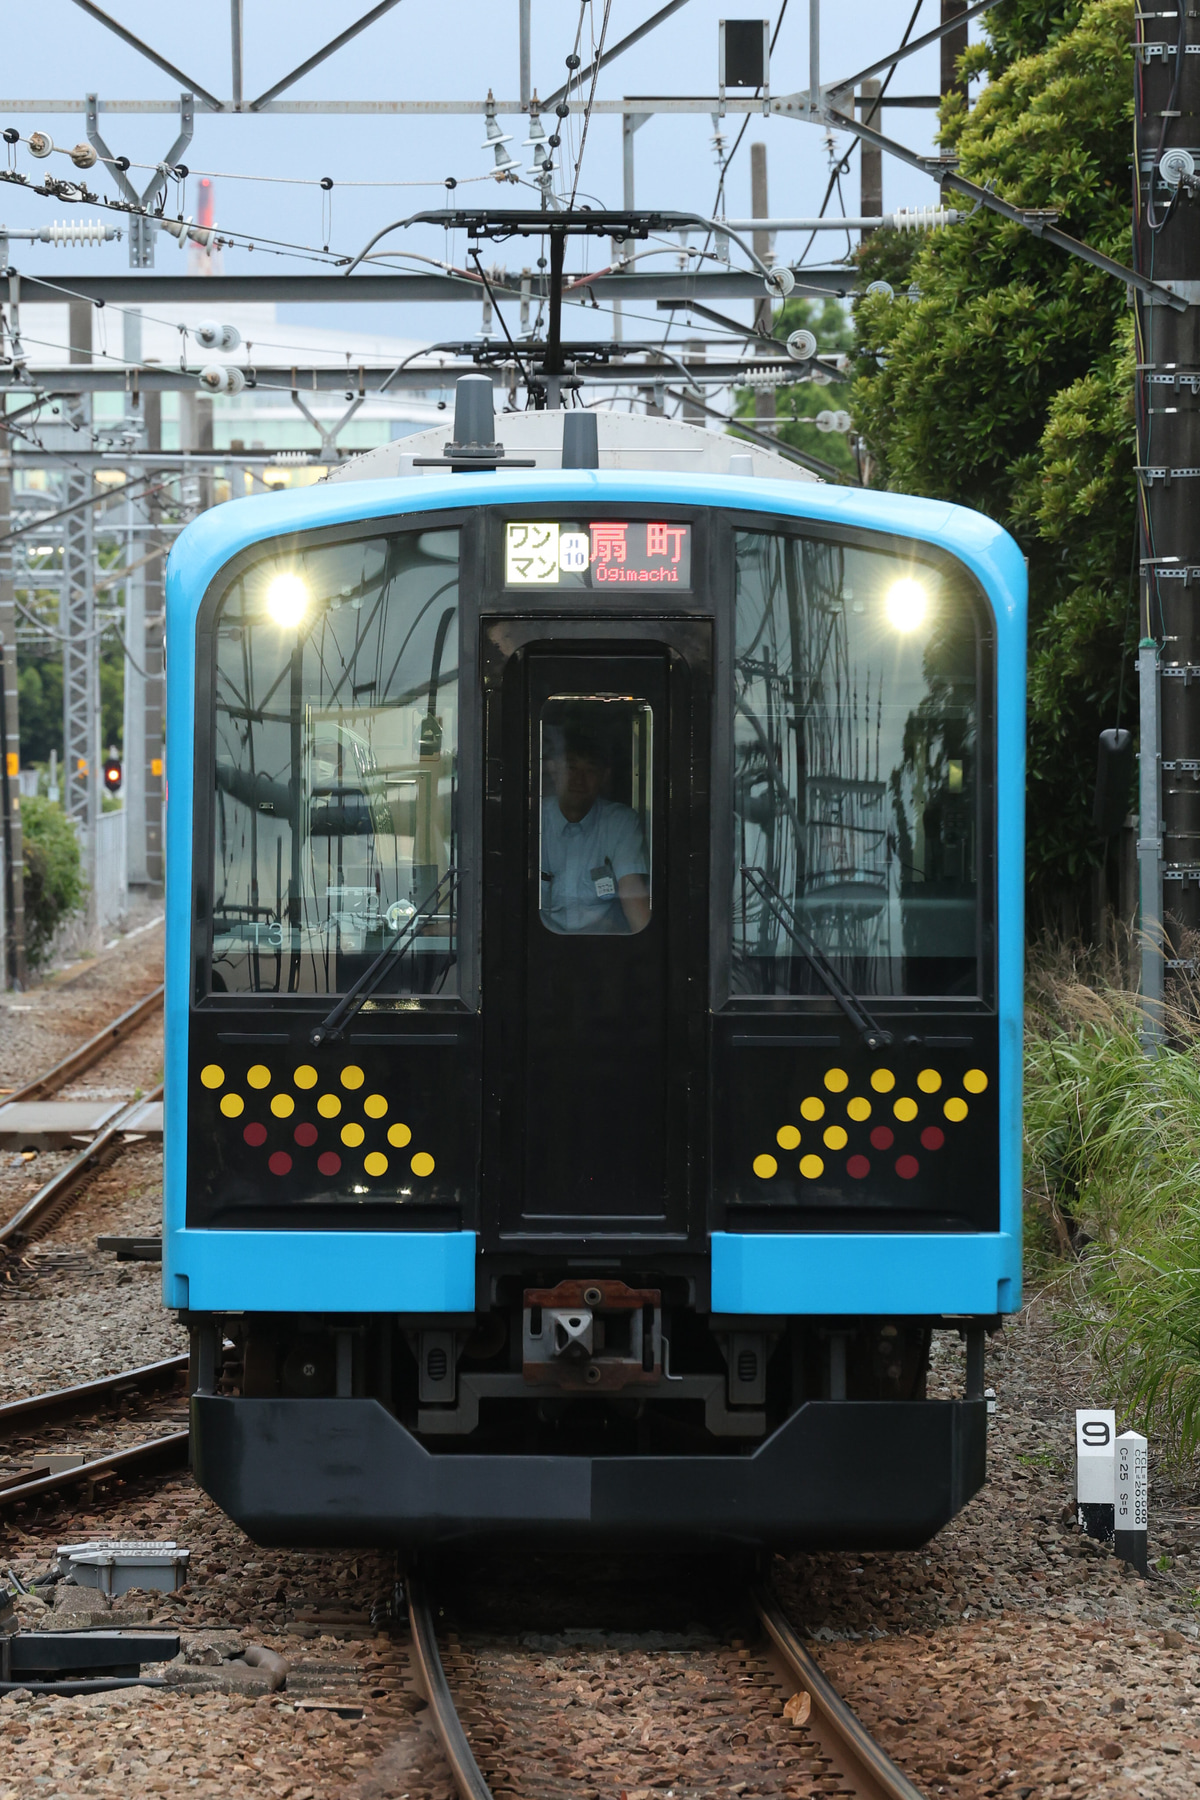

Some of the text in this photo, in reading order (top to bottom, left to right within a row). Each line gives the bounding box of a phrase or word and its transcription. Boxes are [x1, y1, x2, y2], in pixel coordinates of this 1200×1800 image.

[509, 525, 551, 549] ワン
[511, 556, 557, 579] マン
[564, 552, 585, 566] 10
[596, 563, 679, 582] Ōgimachi
[248, 922, 284, 946] T3
[1082, 1421, 1110, 1447] 9
